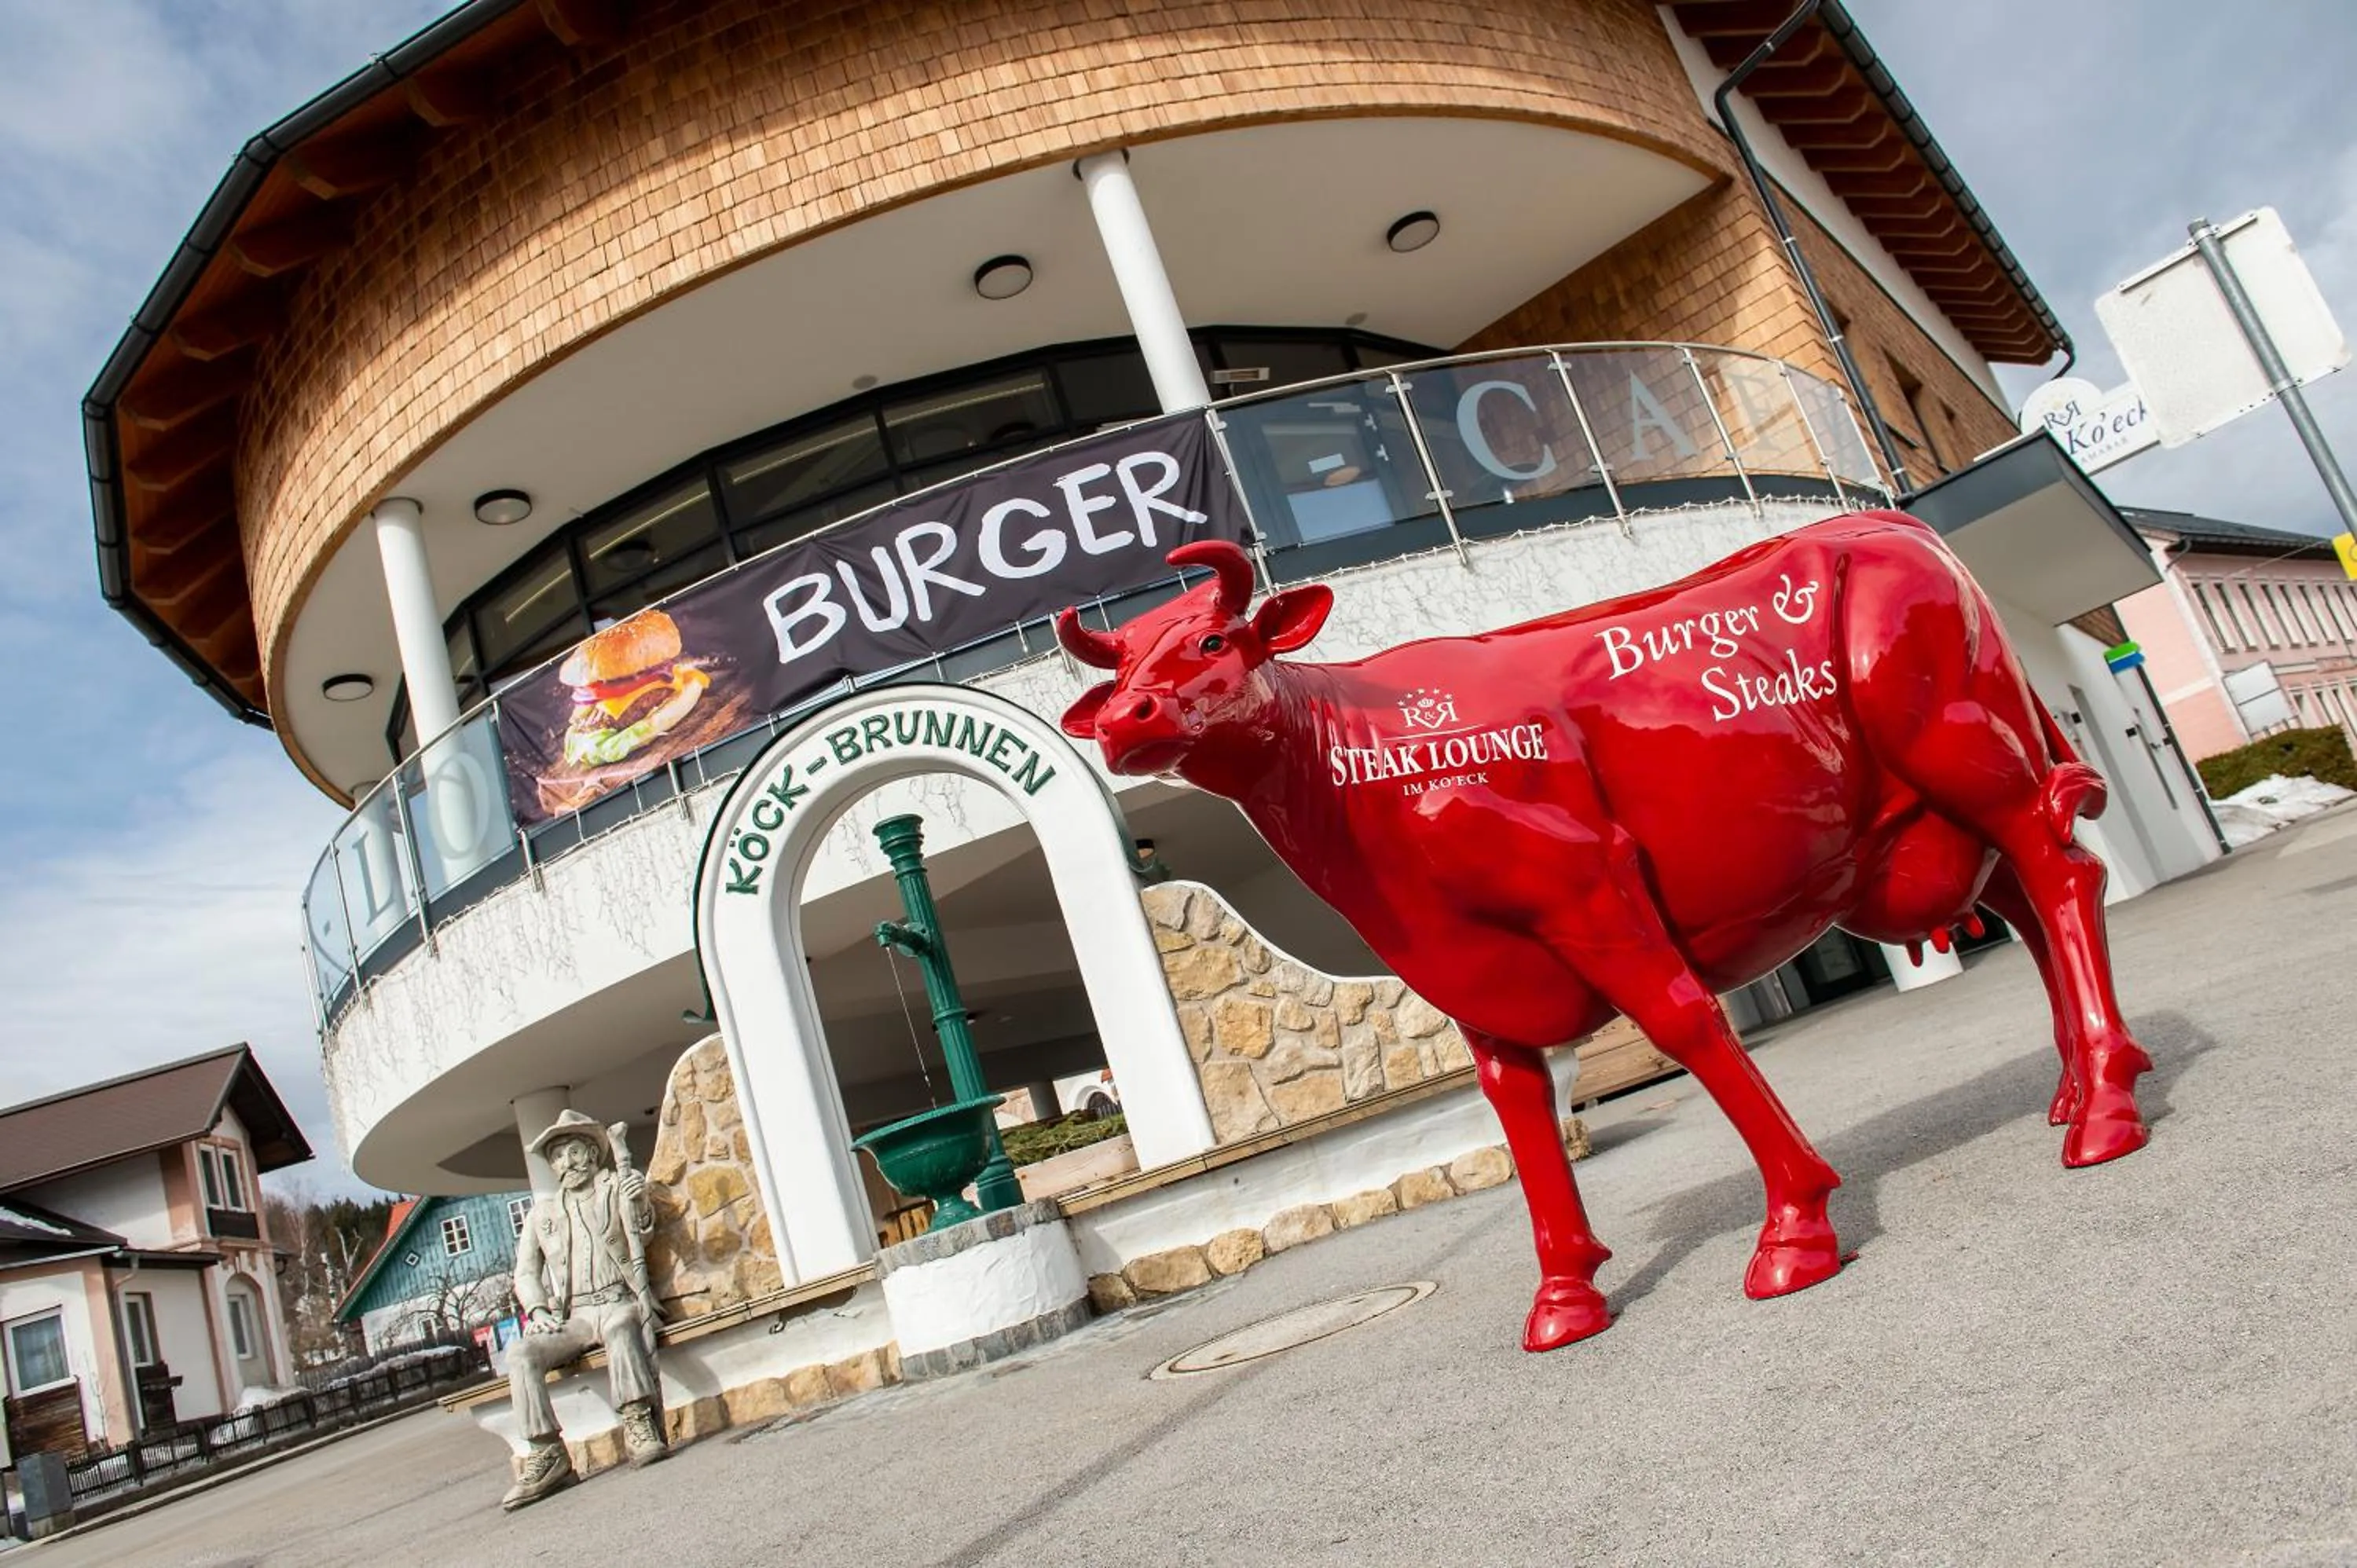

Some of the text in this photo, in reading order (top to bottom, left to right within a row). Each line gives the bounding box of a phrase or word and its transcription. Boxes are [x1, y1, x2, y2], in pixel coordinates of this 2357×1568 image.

[763, 451, 1208, 665] BURGER
[1593, 573, 1820, 681] Burger &
[1700, 650, 1838, 721] Steaks
[1329, 723, 1549, 786] STEAK LOUNGE
[1402, 782, 1424, 797] IM
